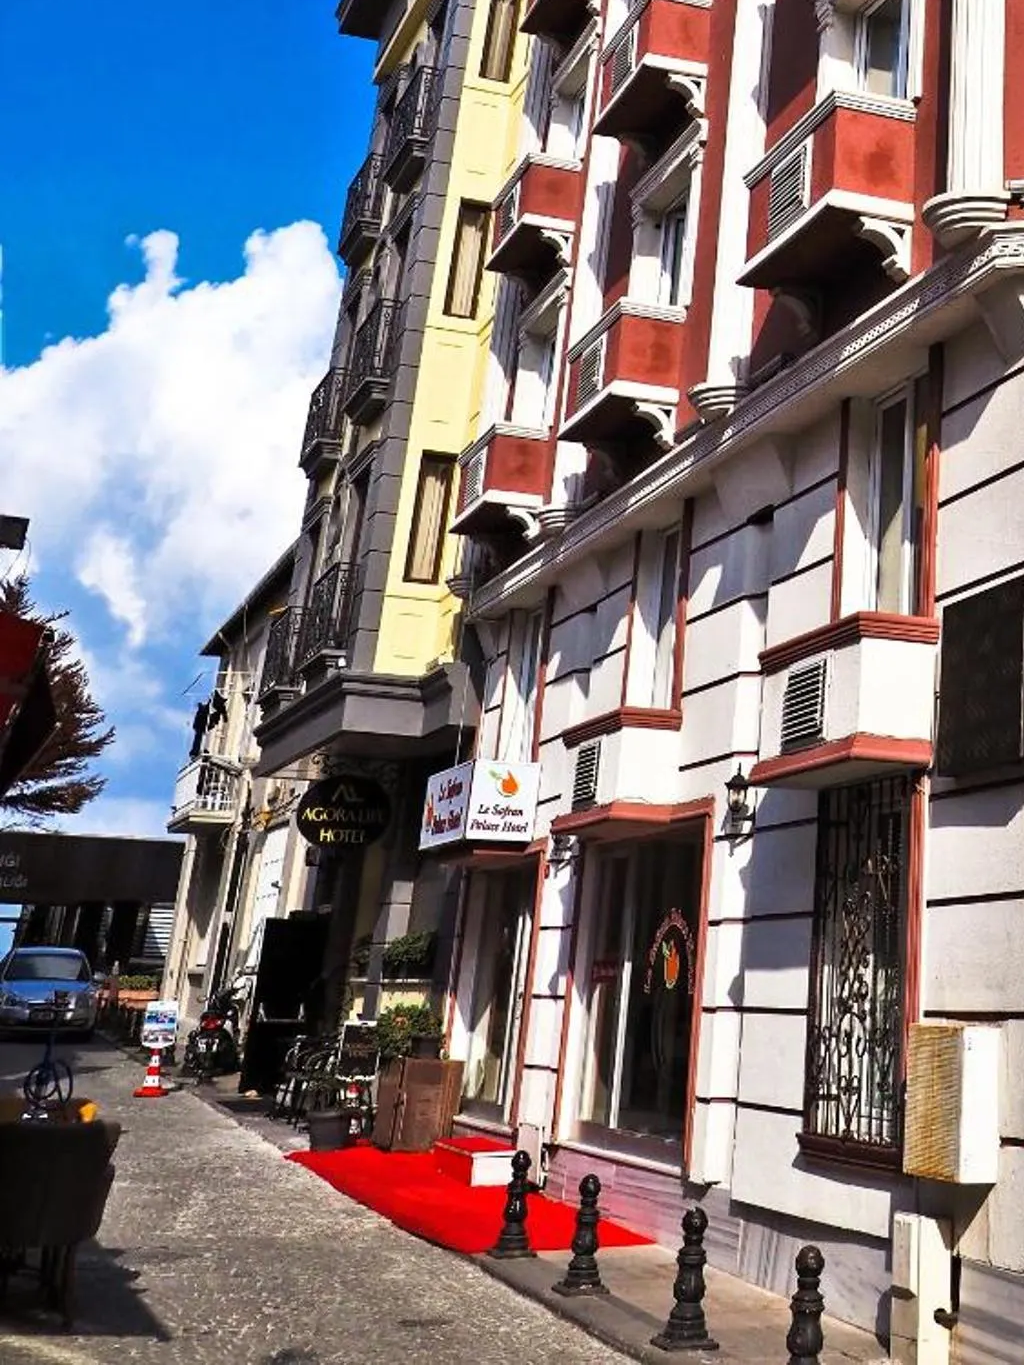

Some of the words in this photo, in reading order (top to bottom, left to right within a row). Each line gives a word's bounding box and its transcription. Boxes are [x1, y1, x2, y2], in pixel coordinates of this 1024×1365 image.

[301, 806, 357, 822] AGORA
[477, 804, 491, 814] Le
[501, 821, 529, 833] Hotel
[319, 827, 366, 843] HOTEL
